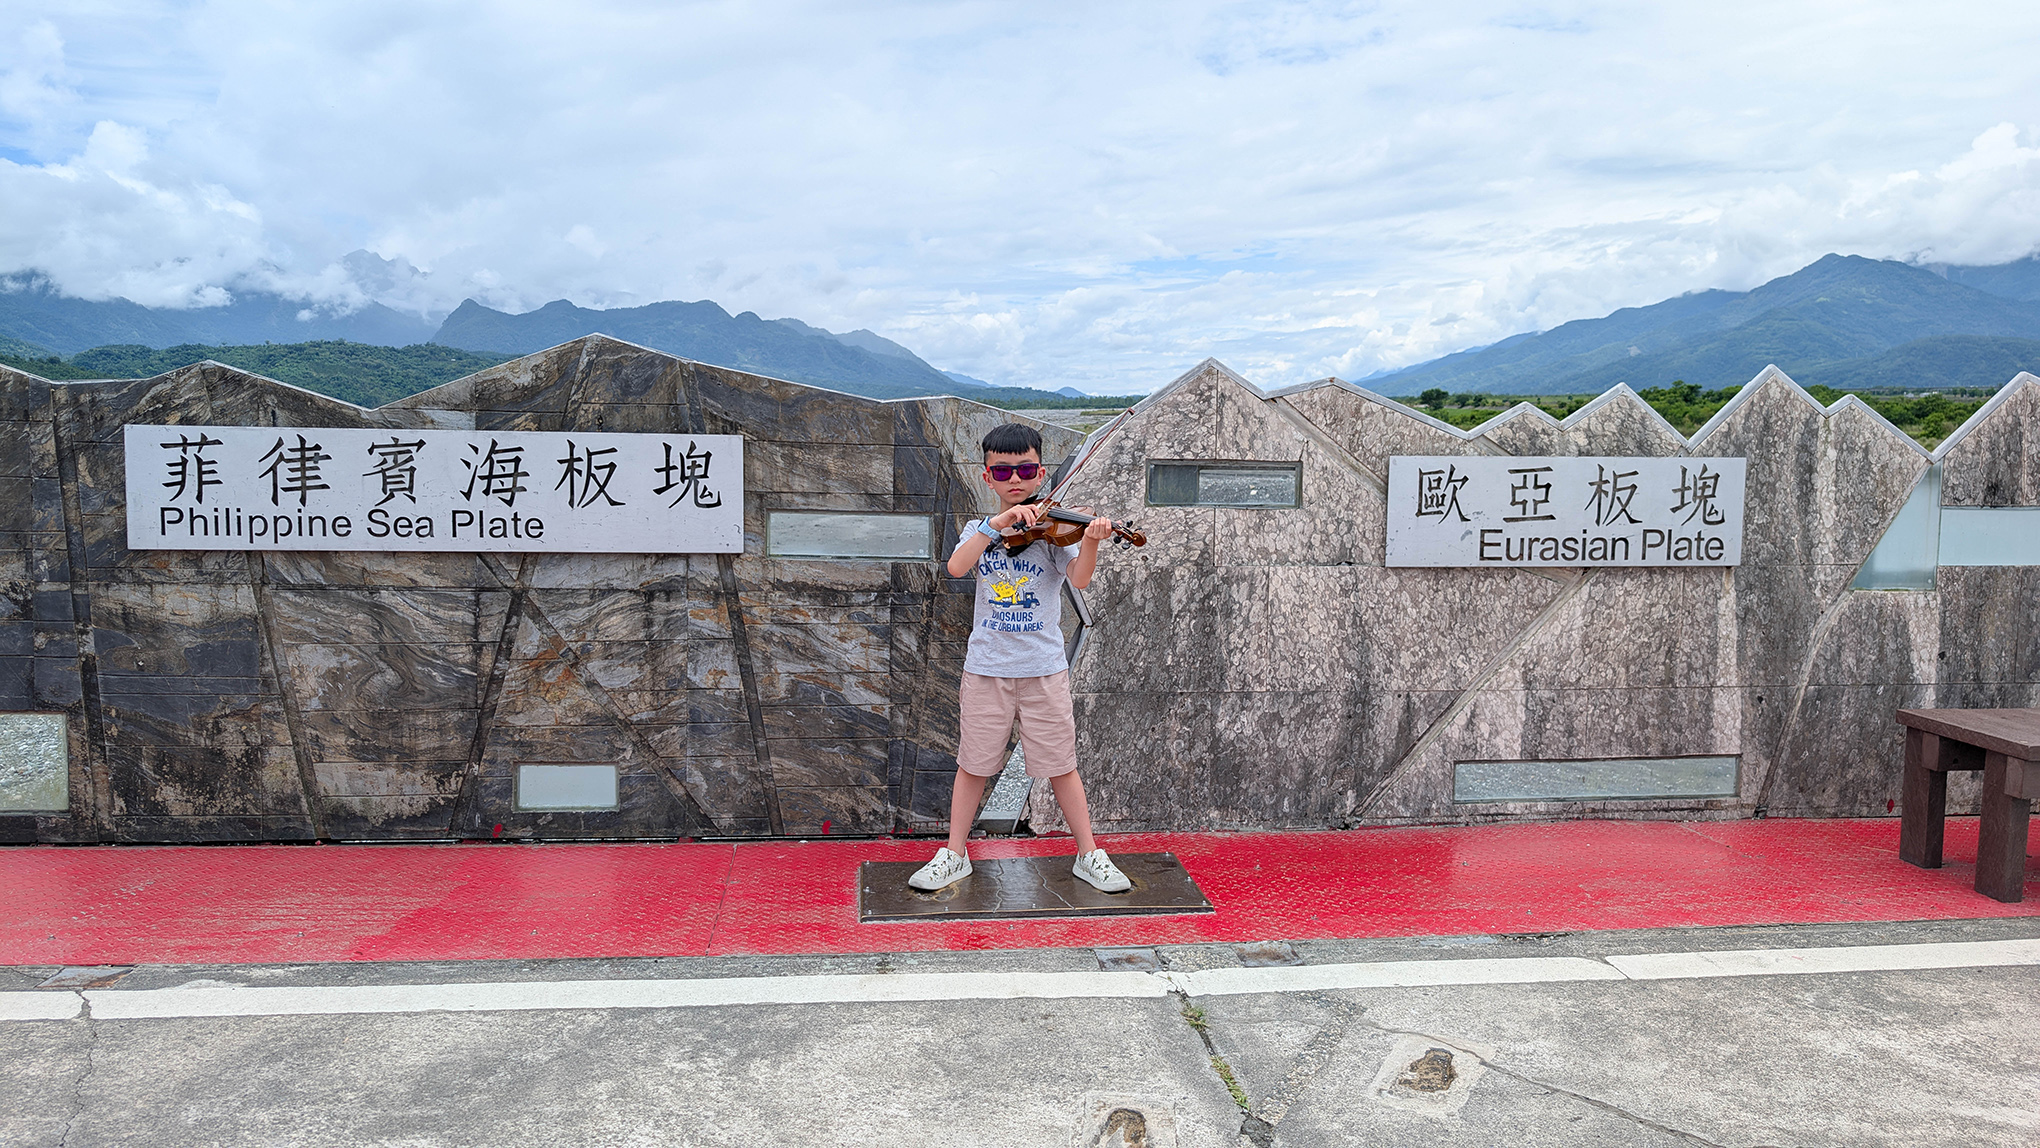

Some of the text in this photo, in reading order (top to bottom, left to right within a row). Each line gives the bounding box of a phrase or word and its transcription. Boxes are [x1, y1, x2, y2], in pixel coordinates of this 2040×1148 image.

[160, 432, 723, 509] 菲律賓海板塊
[1415, 463, 1726, 526] 歐亞板塊
[160, 507, 544, 545] Philippine Sea Plate
[1479, 528, 1725, 562] Eurasian Plate
[1012, 558, 1044, 577] WHAT
[998, 622, 1021, 632] URBAN
[1023, 621, 1044, 632] AREAS
